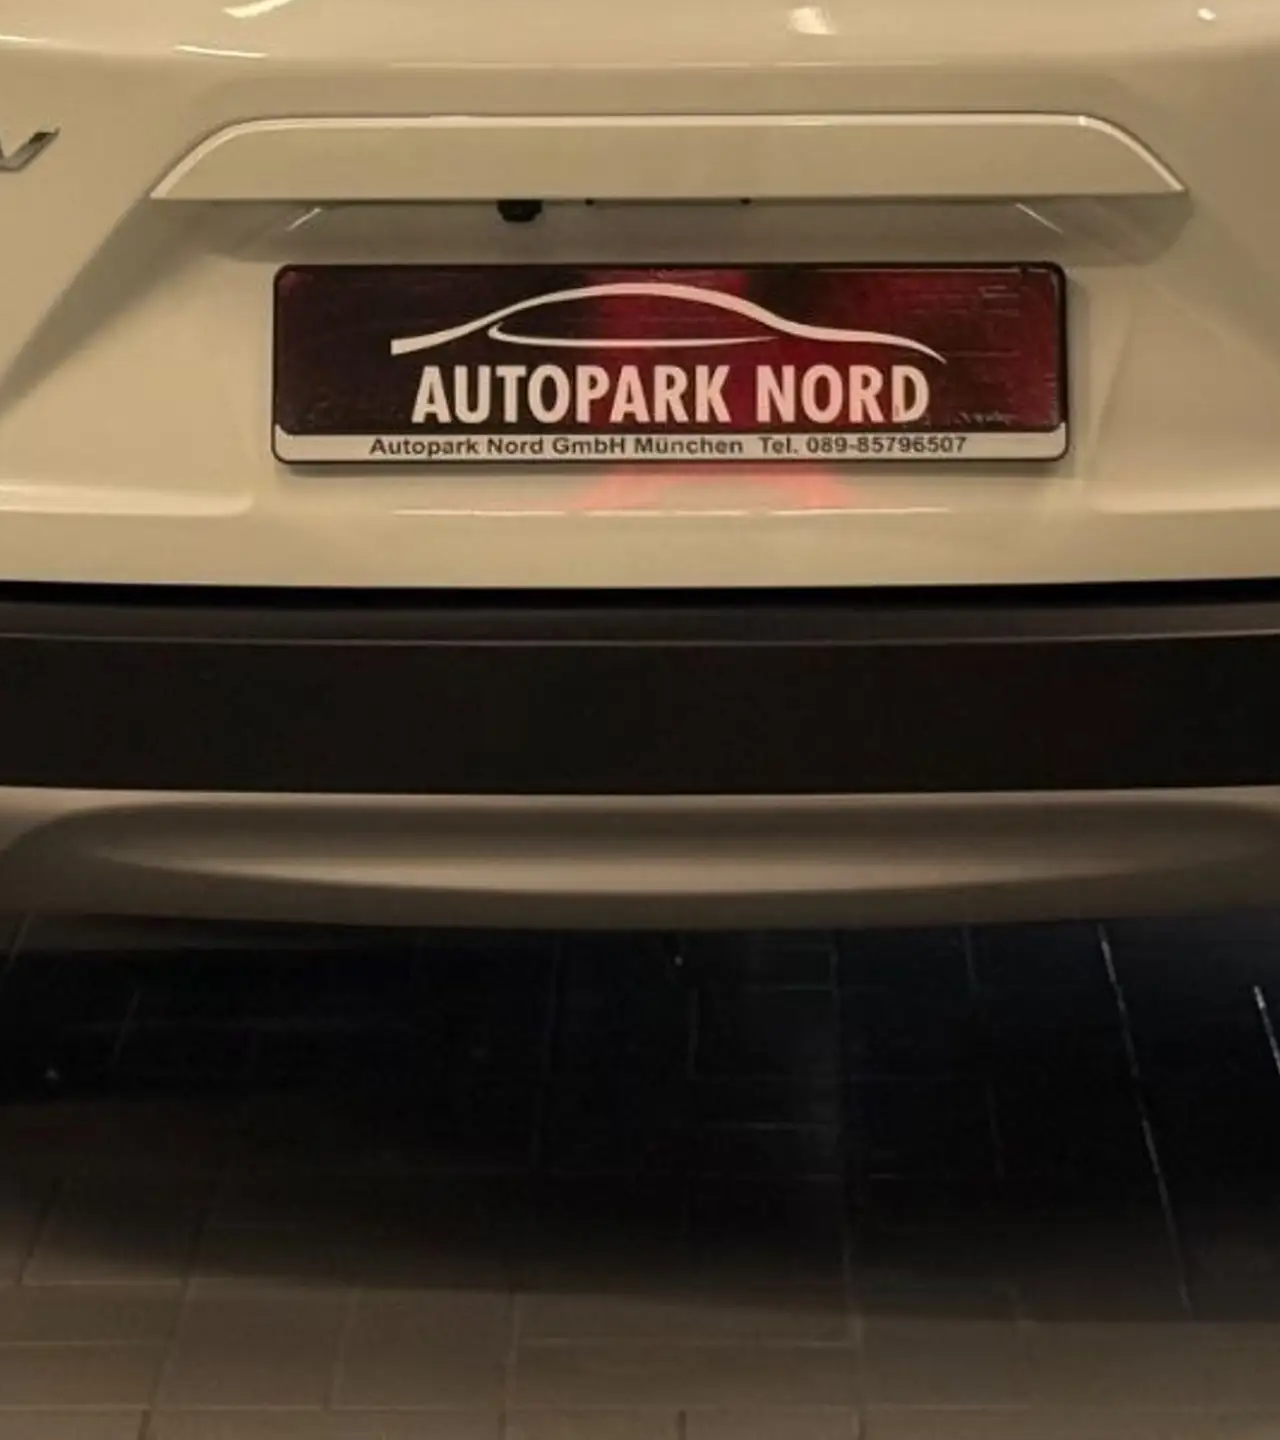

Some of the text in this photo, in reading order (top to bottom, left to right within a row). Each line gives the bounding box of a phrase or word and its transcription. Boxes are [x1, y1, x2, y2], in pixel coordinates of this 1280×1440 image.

[411, 364, 929, 424] AUTOPARK NORD
[369, 435, 967, 458] Autopark Nord GmbH München Tel. 089-85796507
